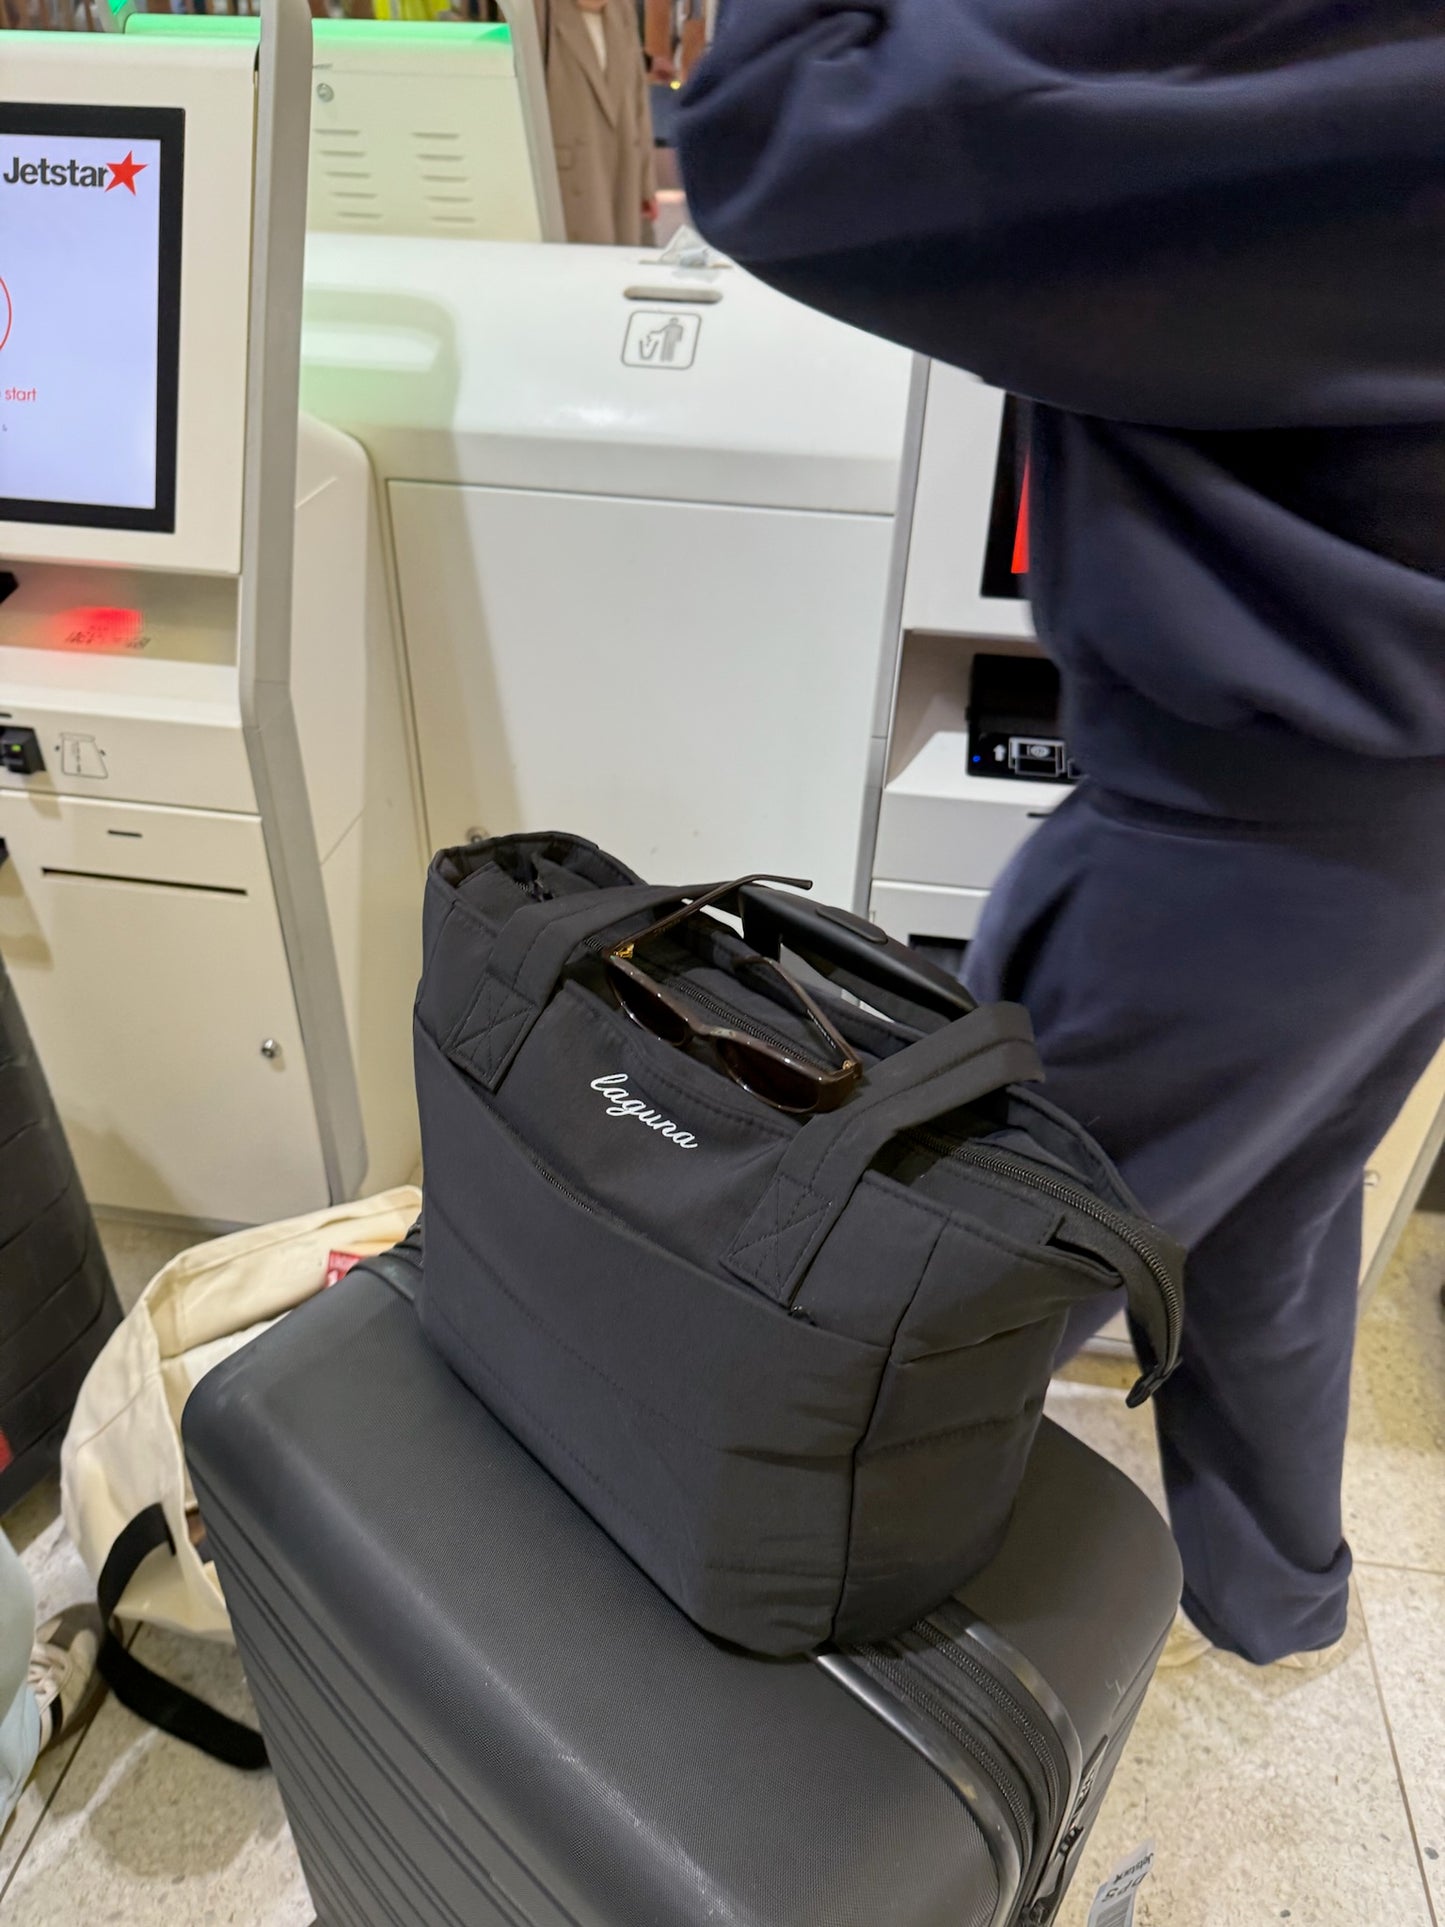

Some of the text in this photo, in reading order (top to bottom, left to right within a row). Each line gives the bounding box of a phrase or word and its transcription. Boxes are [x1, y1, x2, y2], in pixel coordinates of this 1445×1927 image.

[3, 157, 108, 188] Jetstar
[5, 387, 37, 402] start
[590, 1073, 698, 1149] laguna
